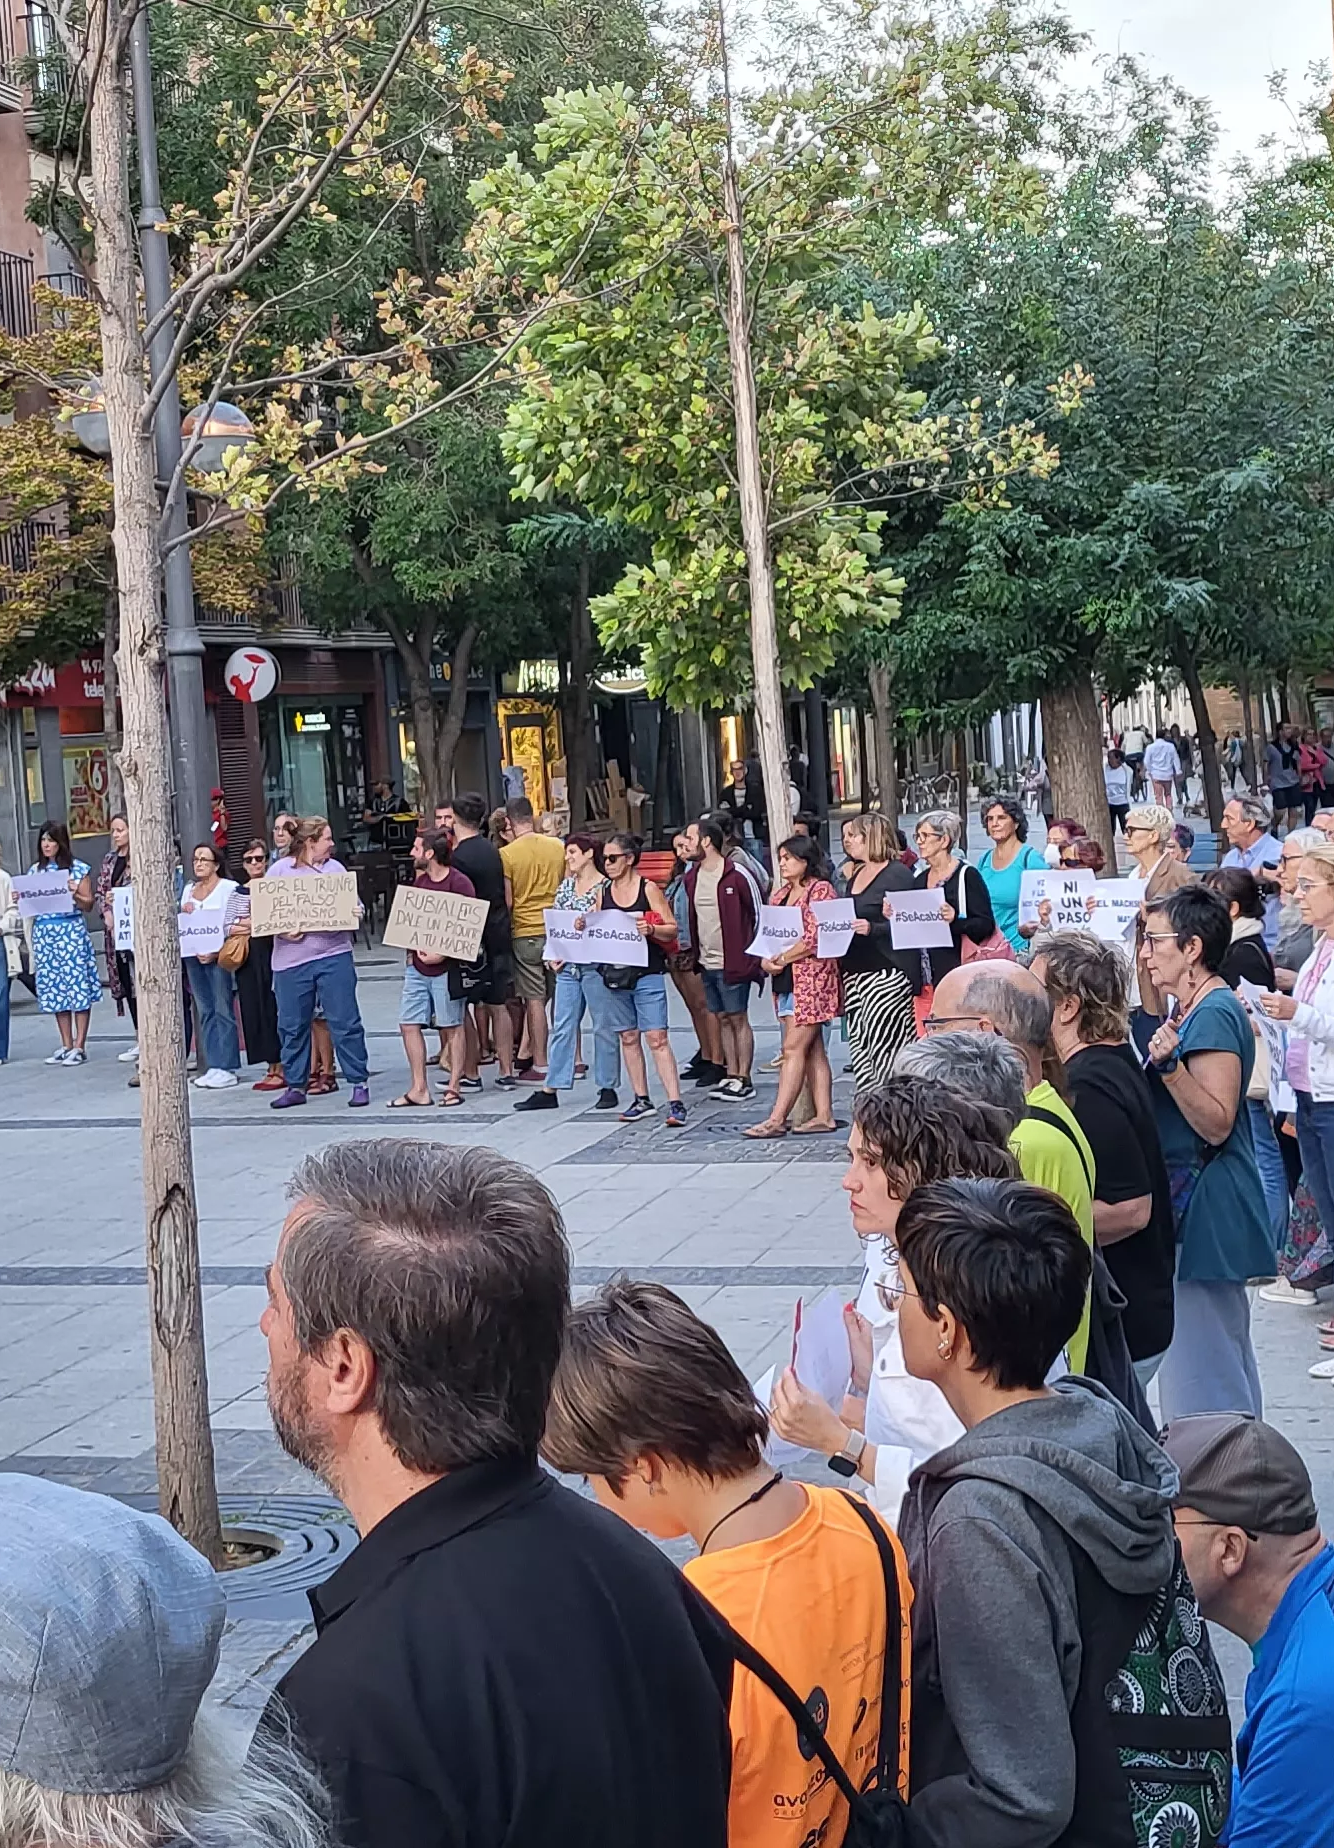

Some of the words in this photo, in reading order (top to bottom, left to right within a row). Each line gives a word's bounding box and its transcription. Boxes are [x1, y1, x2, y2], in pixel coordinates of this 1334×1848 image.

[20, 886, 68, 900] #SeAcabó
[258, 879, 289, 894] POR
[293, 878, 308, 892] EL
[1063, 880, 1079, 894] NI
[272, 895, 293, 910] DEL
[1061, 896, 1083, 909] UN
[269, 906, 337, 921] FEMINISMO
[395, 909, 423, 928] DALE
[427, 918, 441, 930] UN
[1057, 911, 1092, 924] PASO
[410, 931, 419, 946] A
[423, 933, 436, 947] TU
[439, 936, 477, 956] MADRE
